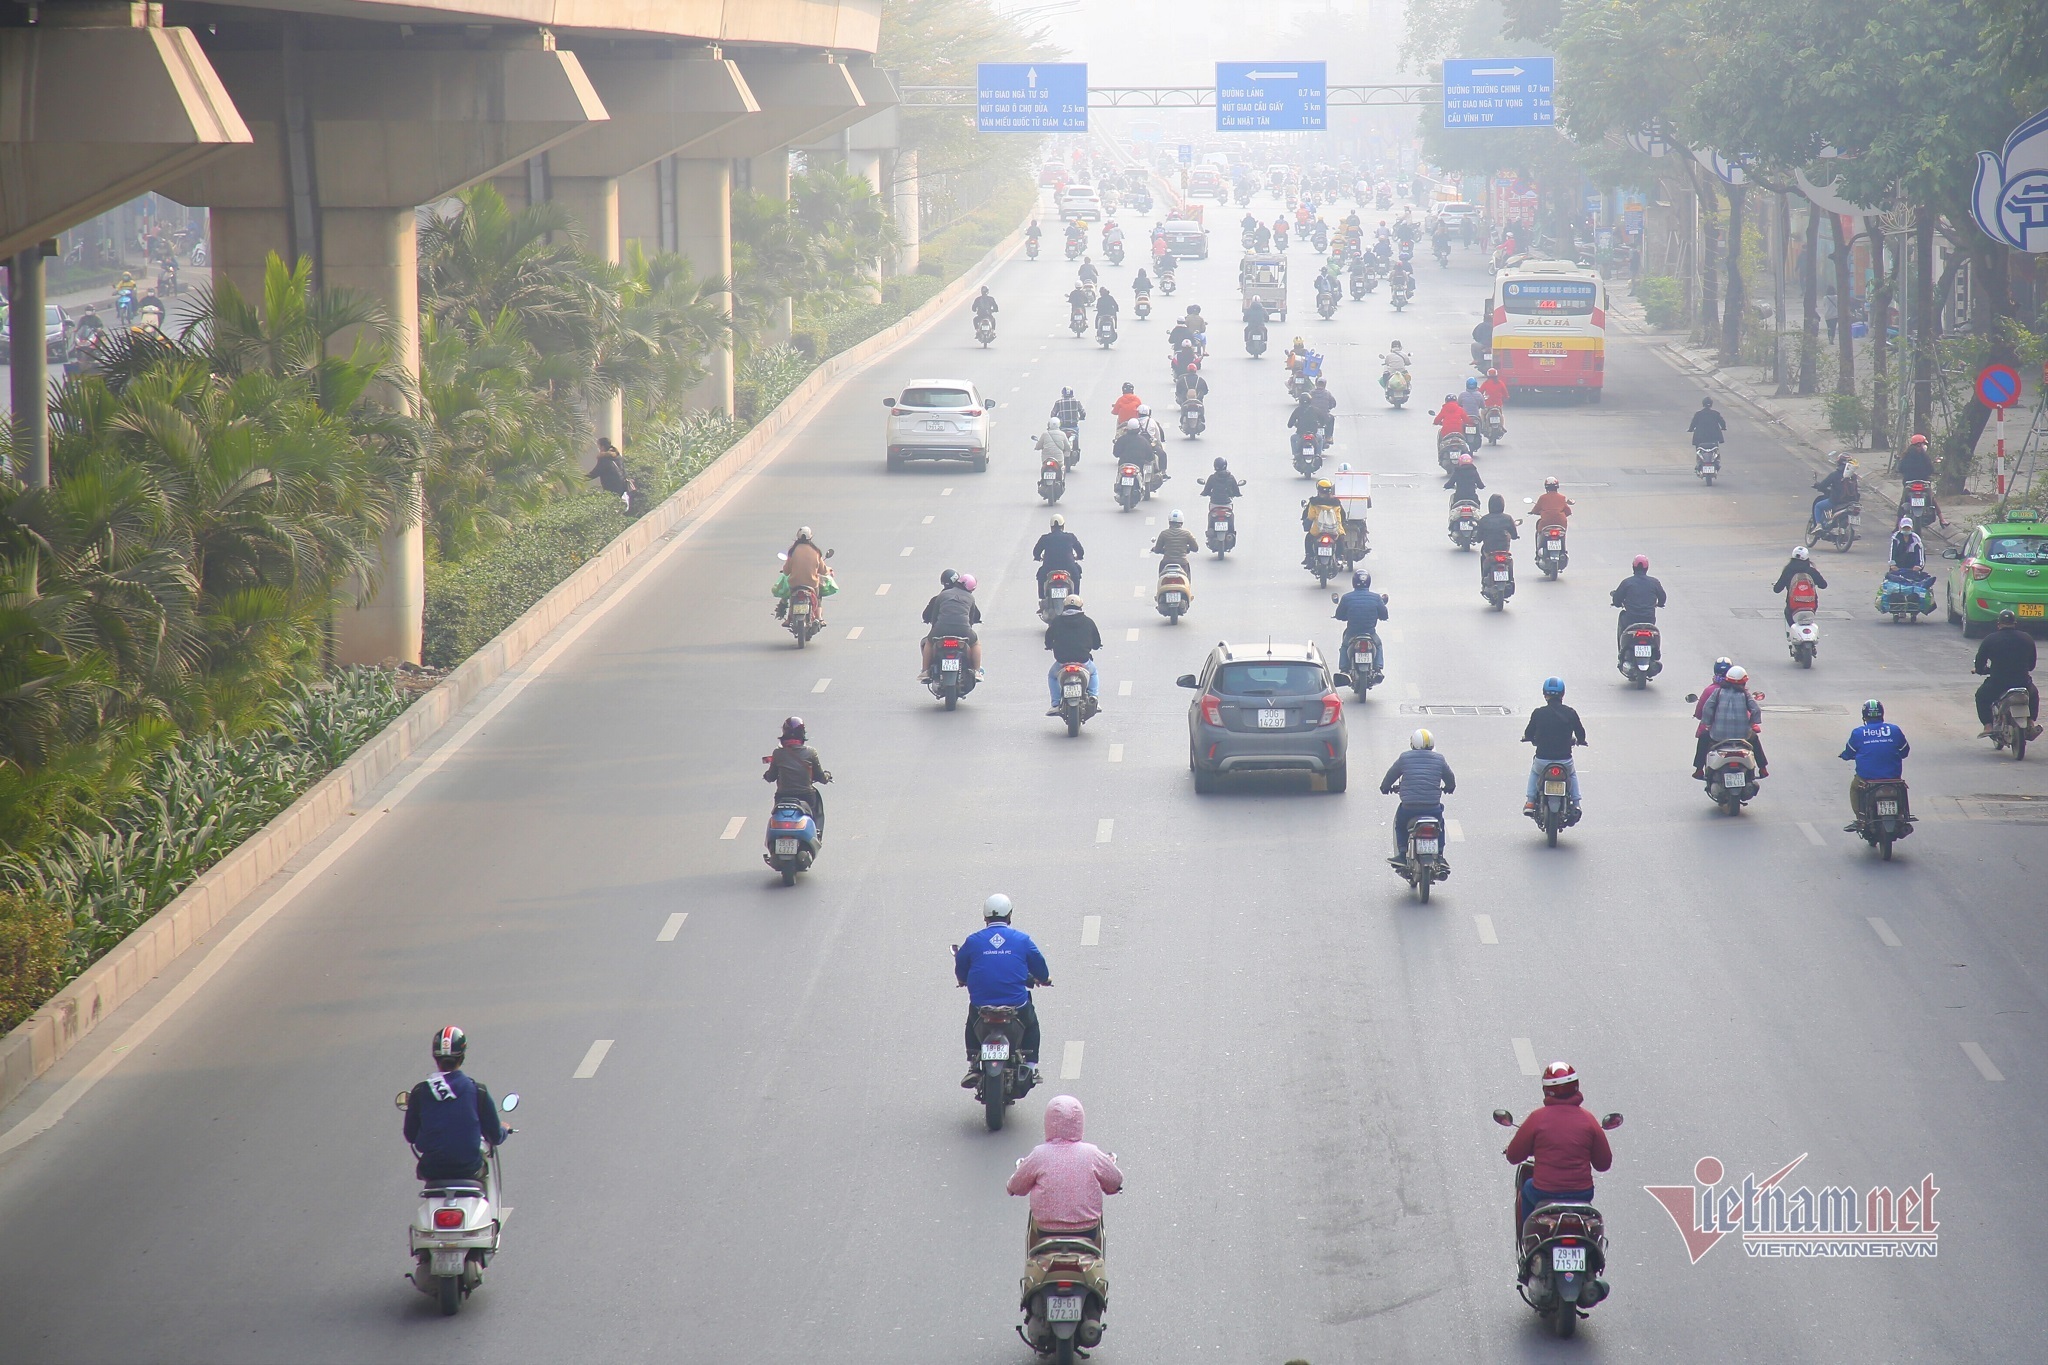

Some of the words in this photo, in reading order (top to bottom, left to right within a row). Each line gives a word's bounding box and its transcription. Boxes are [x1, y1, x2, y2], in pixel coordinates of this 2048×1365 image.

[980, 88, 993, 98] NÚT
[995, 90, 1010, 98] GIAO
[1222, 87, 1244, 98] ĐƯỜNG
[1447, 83, 1470, 94] ĐƯỜNG
[1472, 83, 1498, 94] TRƯỜNG
[1500, 85, 1520, 93] CHINH
[980, 102, 993, 112] NÚT
[995, 104, 1010, 112] GIAO
[1062, 104, 1072, 113] 2.5
[1074, 104, 1085, 112] km
[1222, 101, 1234, 111] NÚT
[1236, 103, 1252, 111] GIAO
[1448, 98, 1461, 108] NÚT
[1462, 100, 1477, 108] GIAO
[1310, 116, 1320, 124] km
[1482, 113, 1494, 121] TUY
[1062, 118, 1072, 127] 4.3
[1074, 118, 1085, 126] km
[1526, 317, 1551, 325] BẮC
[1264, 709, 1279, 718] 30G
[1259, 718, 1284, 727] 142.97
[1556, 1259, 1584, 1270] 715.70
[1053, 1298, 1076, 1308] 29-G1
[1050, 1309, 1079, 1319] 472.30
